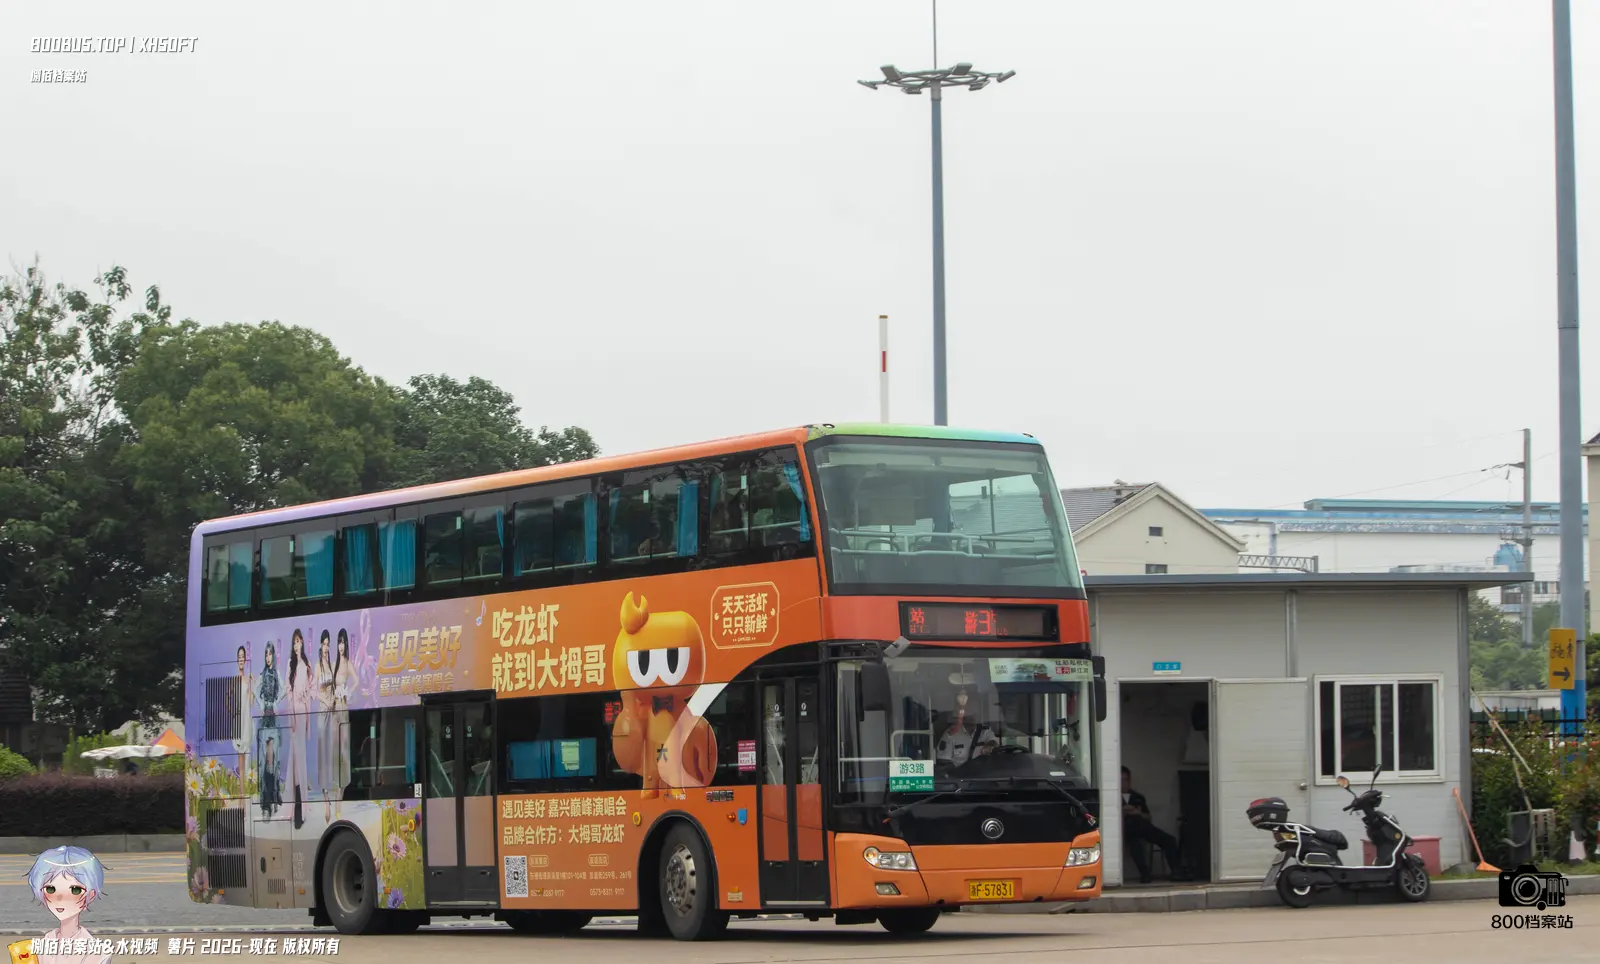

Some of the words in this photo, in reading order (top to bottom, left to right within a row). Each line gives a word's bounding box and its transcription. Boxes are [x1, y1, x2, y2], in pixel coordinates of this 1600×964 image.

[722, 593, 768, 615] 天天活虾
[492, 603, 560, 648] 吃龙虾
[722, 613, 768, 636] 只只新鲜
[376, 625, 462, 674] 遇见美好
[491, 644, 606, 693] 就到大拇哥
[899, 763, 925, 775] 游3路
[502, 799, 545, 818] 遇见美好
[548, 796, 626, 817] 嘉兴巅峰演唱会
